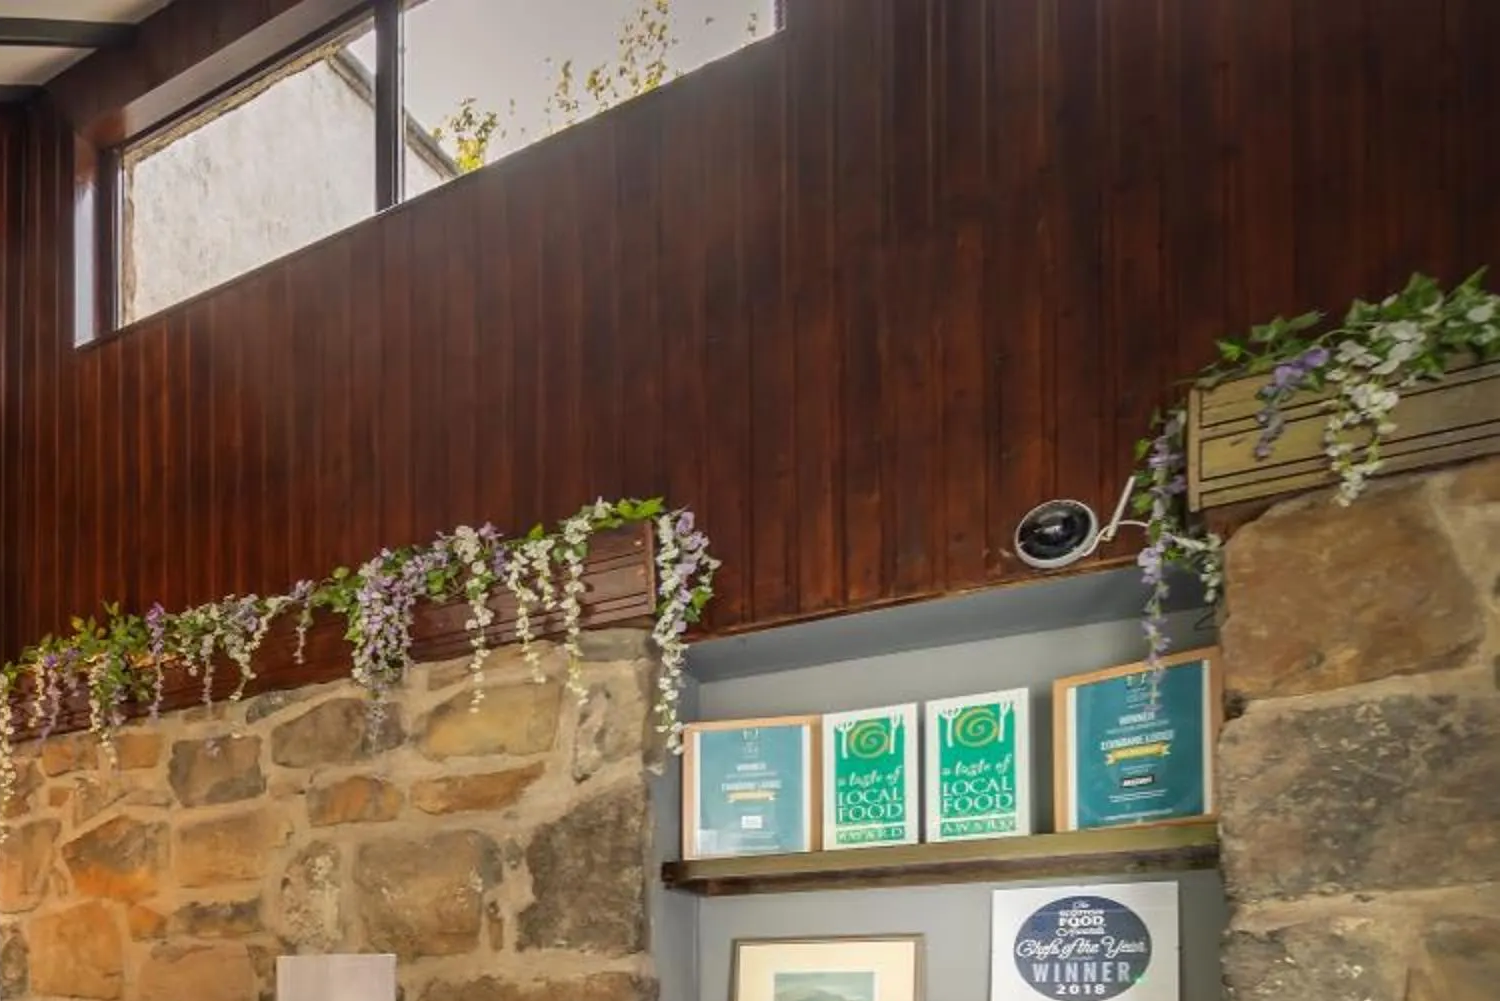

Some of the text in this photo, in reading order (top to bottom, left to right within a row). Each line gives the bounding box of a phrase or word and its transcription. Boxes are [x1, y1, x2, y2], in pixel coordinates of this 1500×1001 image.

[955, 759, 991, 777] taste
[995, 753, 1013, 775] of
[850, 771, 883, 788] taste
[886, 765, 903, 786] of
[943, 776, 1012, 796] LOCAL
[838, 787, 903, 805] LOCAL
[943, 793, 1013, 813] FOOD
[838, 803, 903, 822] FOOD
[1059, 916, 1104, 927] FOOD
[1032, 962, 1132, 983] WINNER
[1056, 983, 1106, 995] 2018
